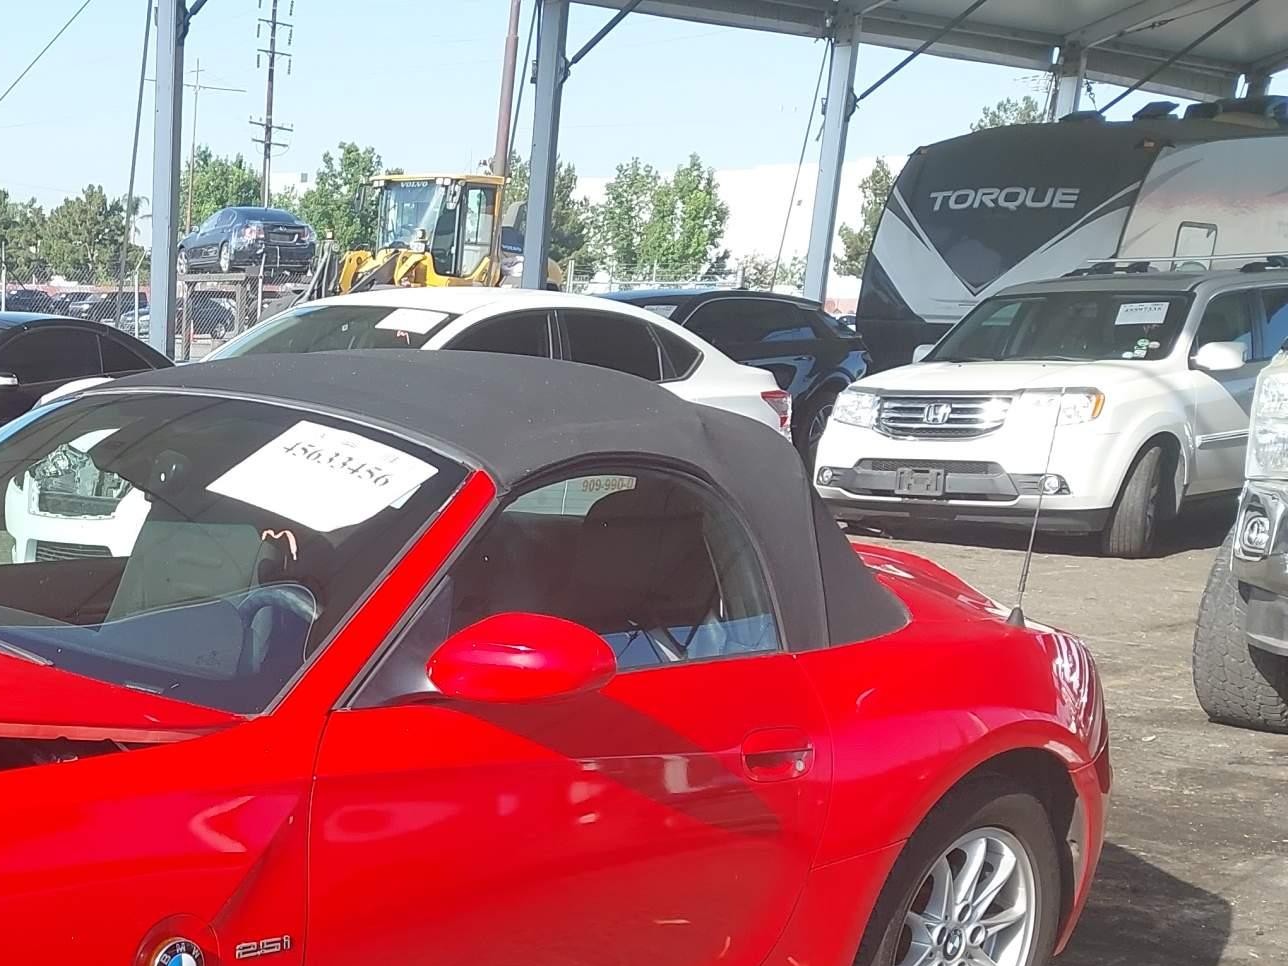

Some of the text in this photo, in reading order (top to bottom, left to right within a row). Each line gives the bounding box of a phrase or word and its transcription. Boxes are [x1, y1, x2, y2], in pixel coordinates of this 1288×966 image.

[930, 186, 1080, 211] TORQUE
[283, 442, 392, 487] 45633456
[162, 942, 200, 966] BMW
